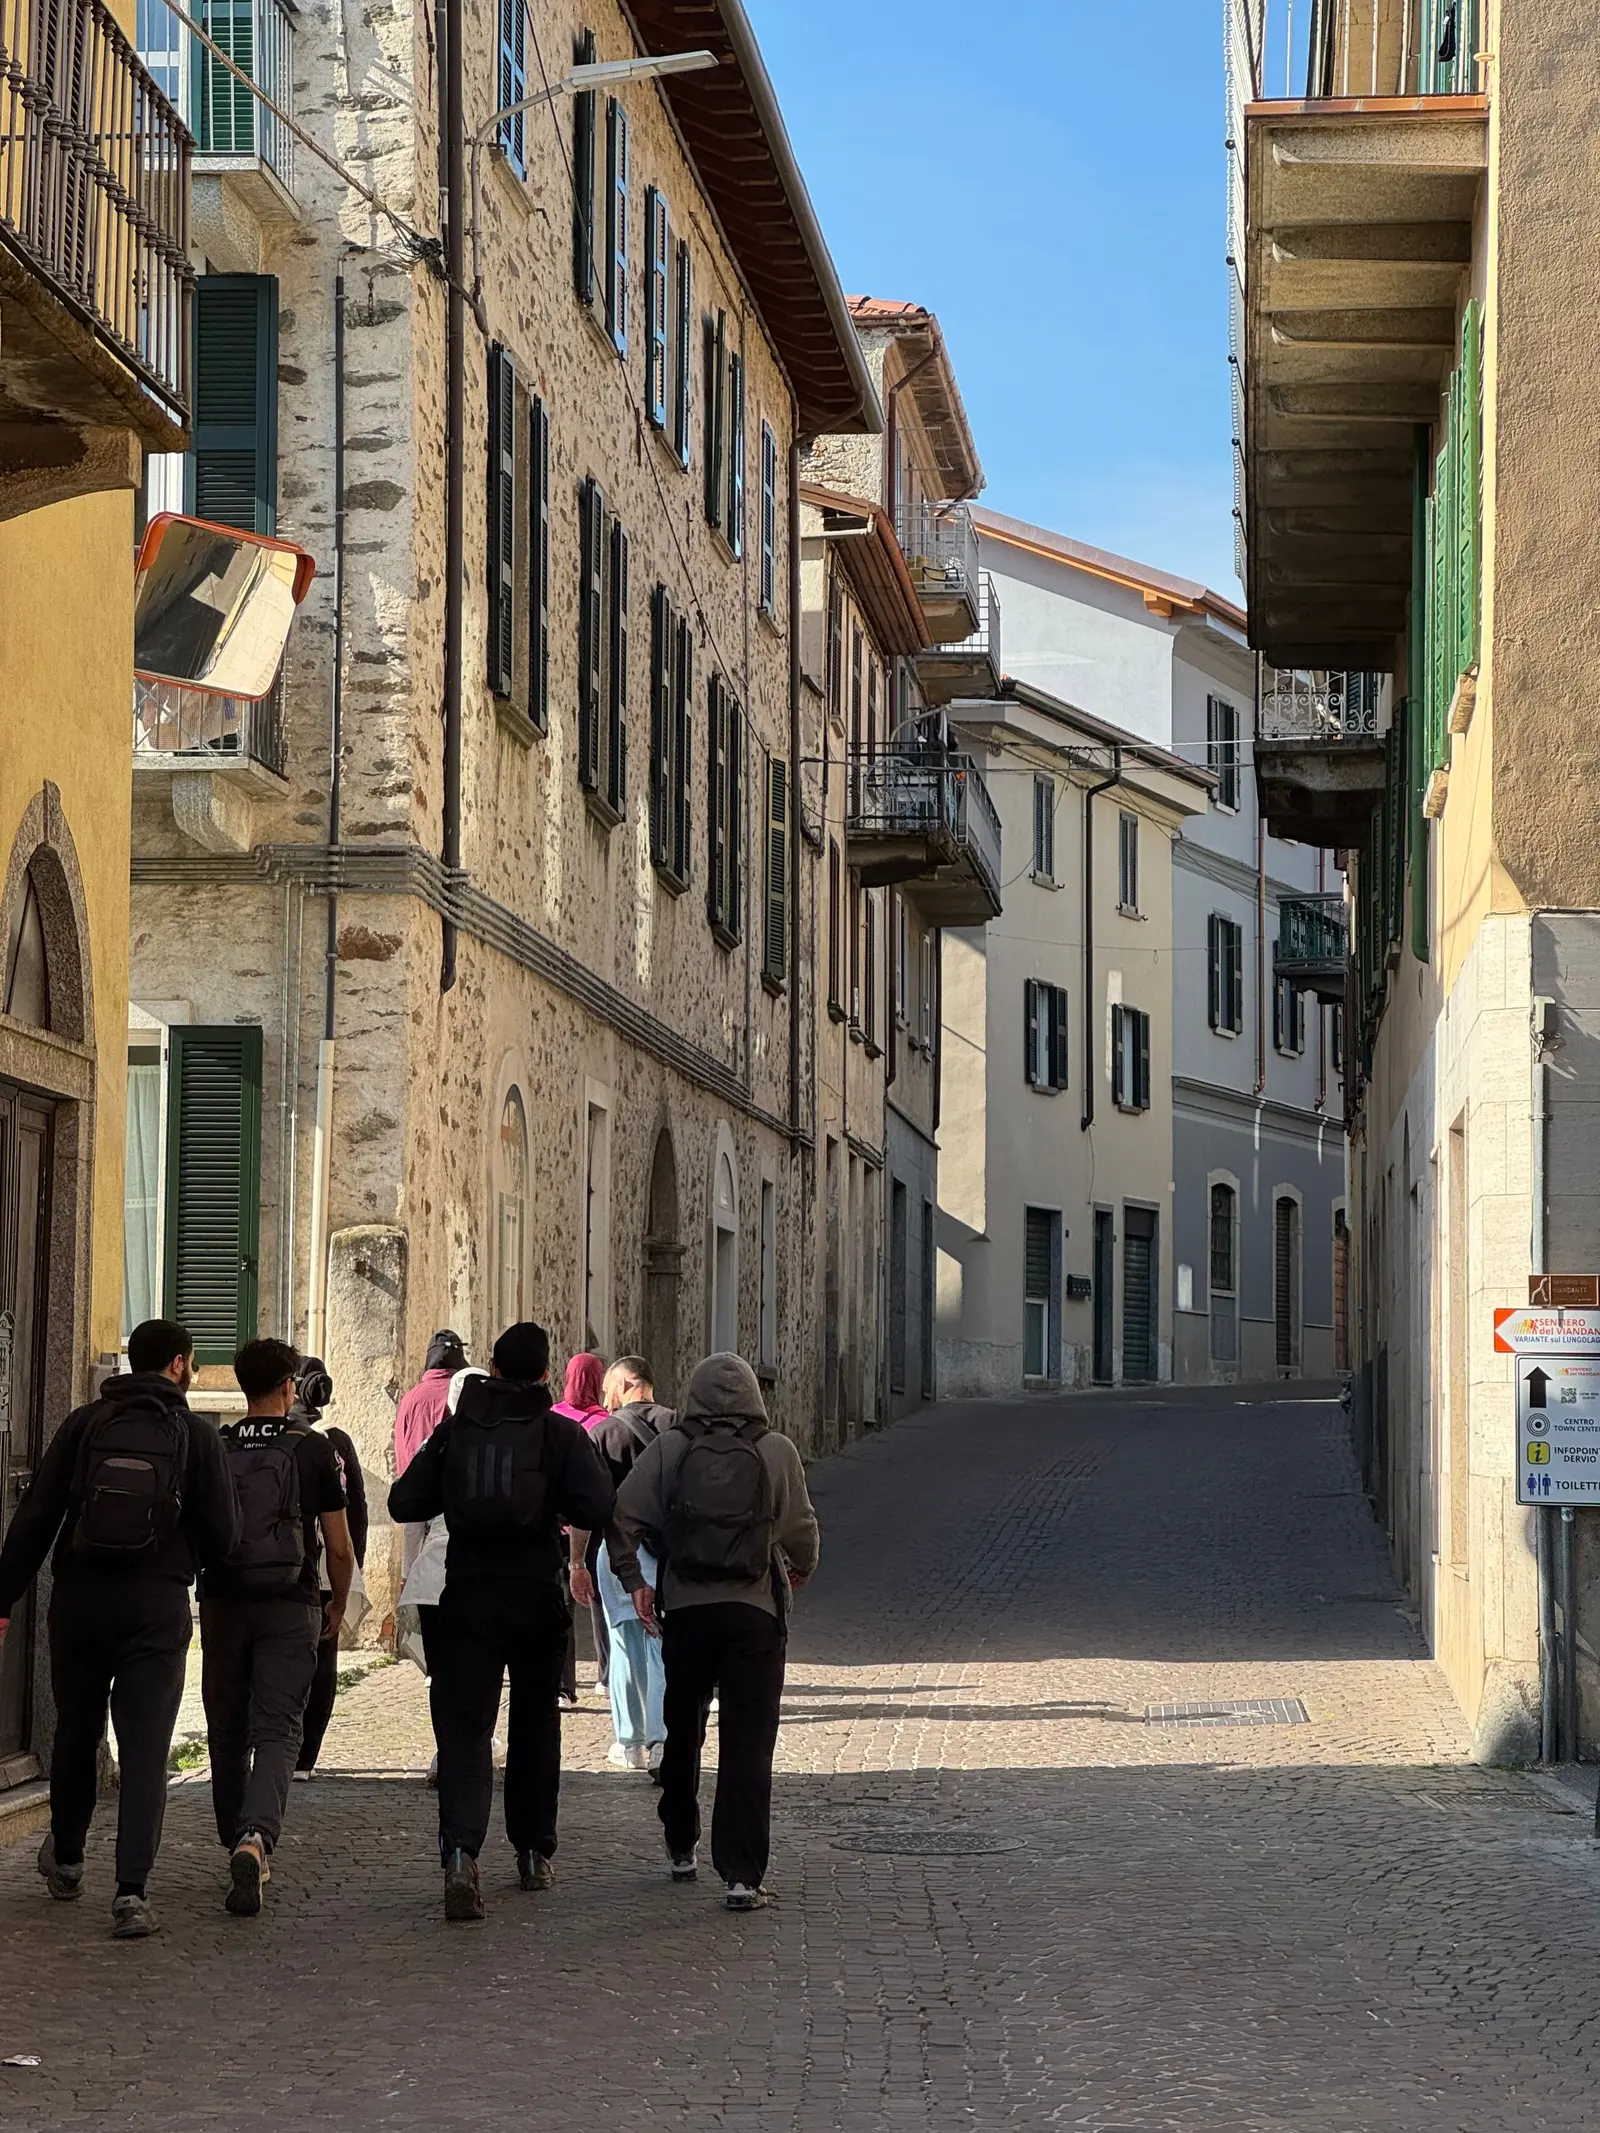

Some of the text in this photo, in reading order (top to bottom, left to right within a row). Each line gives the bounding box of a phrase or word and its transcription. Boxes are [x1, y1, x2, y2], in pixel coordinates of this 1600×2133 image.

[1539, 1318, 1586, 1327] SENTIERO
[1540, 1327, 1554, 1335] del
[1515, 1335, 1548, 1343] VARIANTE
[1563, 1455, 1597, 1463] DERVIO
